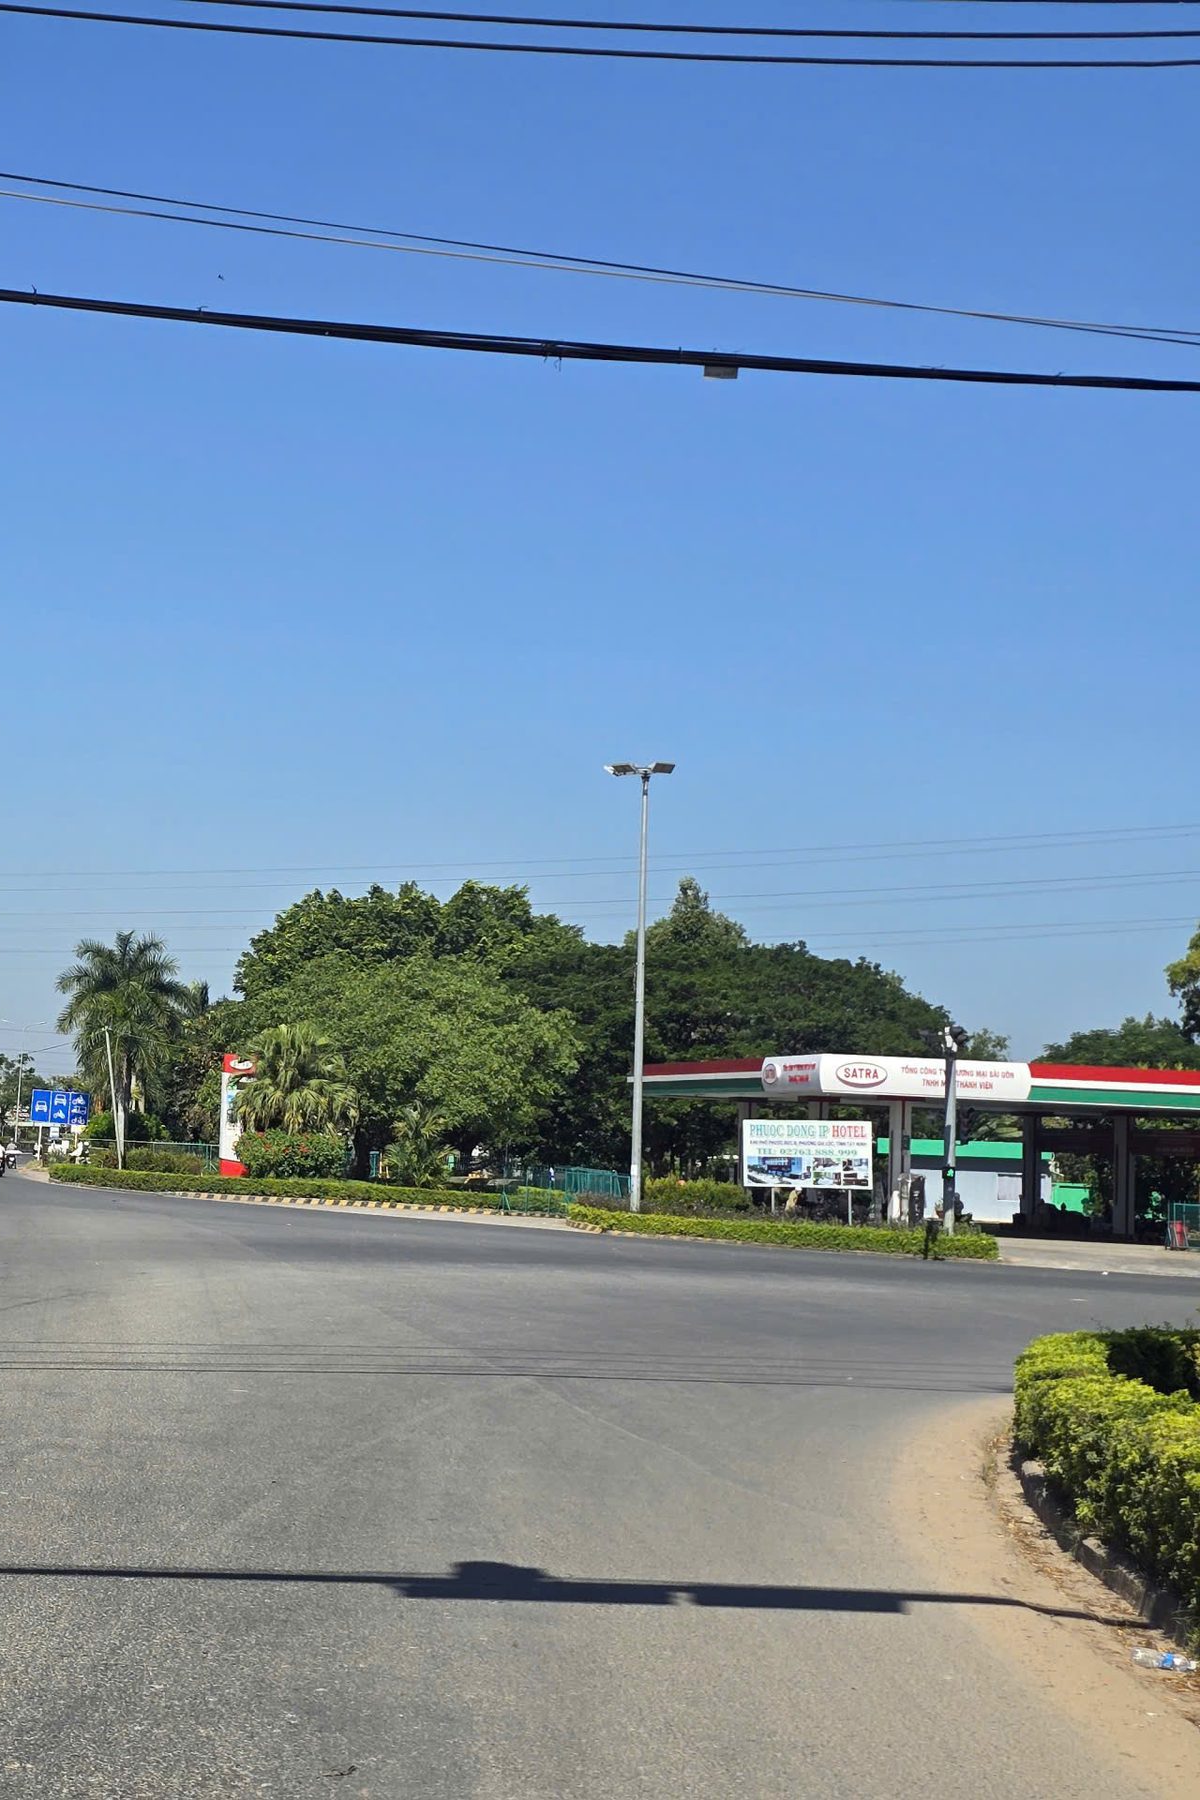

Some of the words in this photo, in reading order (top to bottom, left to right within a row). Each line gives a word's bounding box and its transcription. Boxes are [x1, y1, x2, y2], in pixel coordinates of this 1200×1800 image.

[844, 1067, 879, 1080] SATRA
[920, 1066, 937, 1075] CÔNG
[922, 1078, 940, 1087] TNHH
[818, 1125, 830, 1138] IP
[832, 1125, 867, 1138] HOTEL
